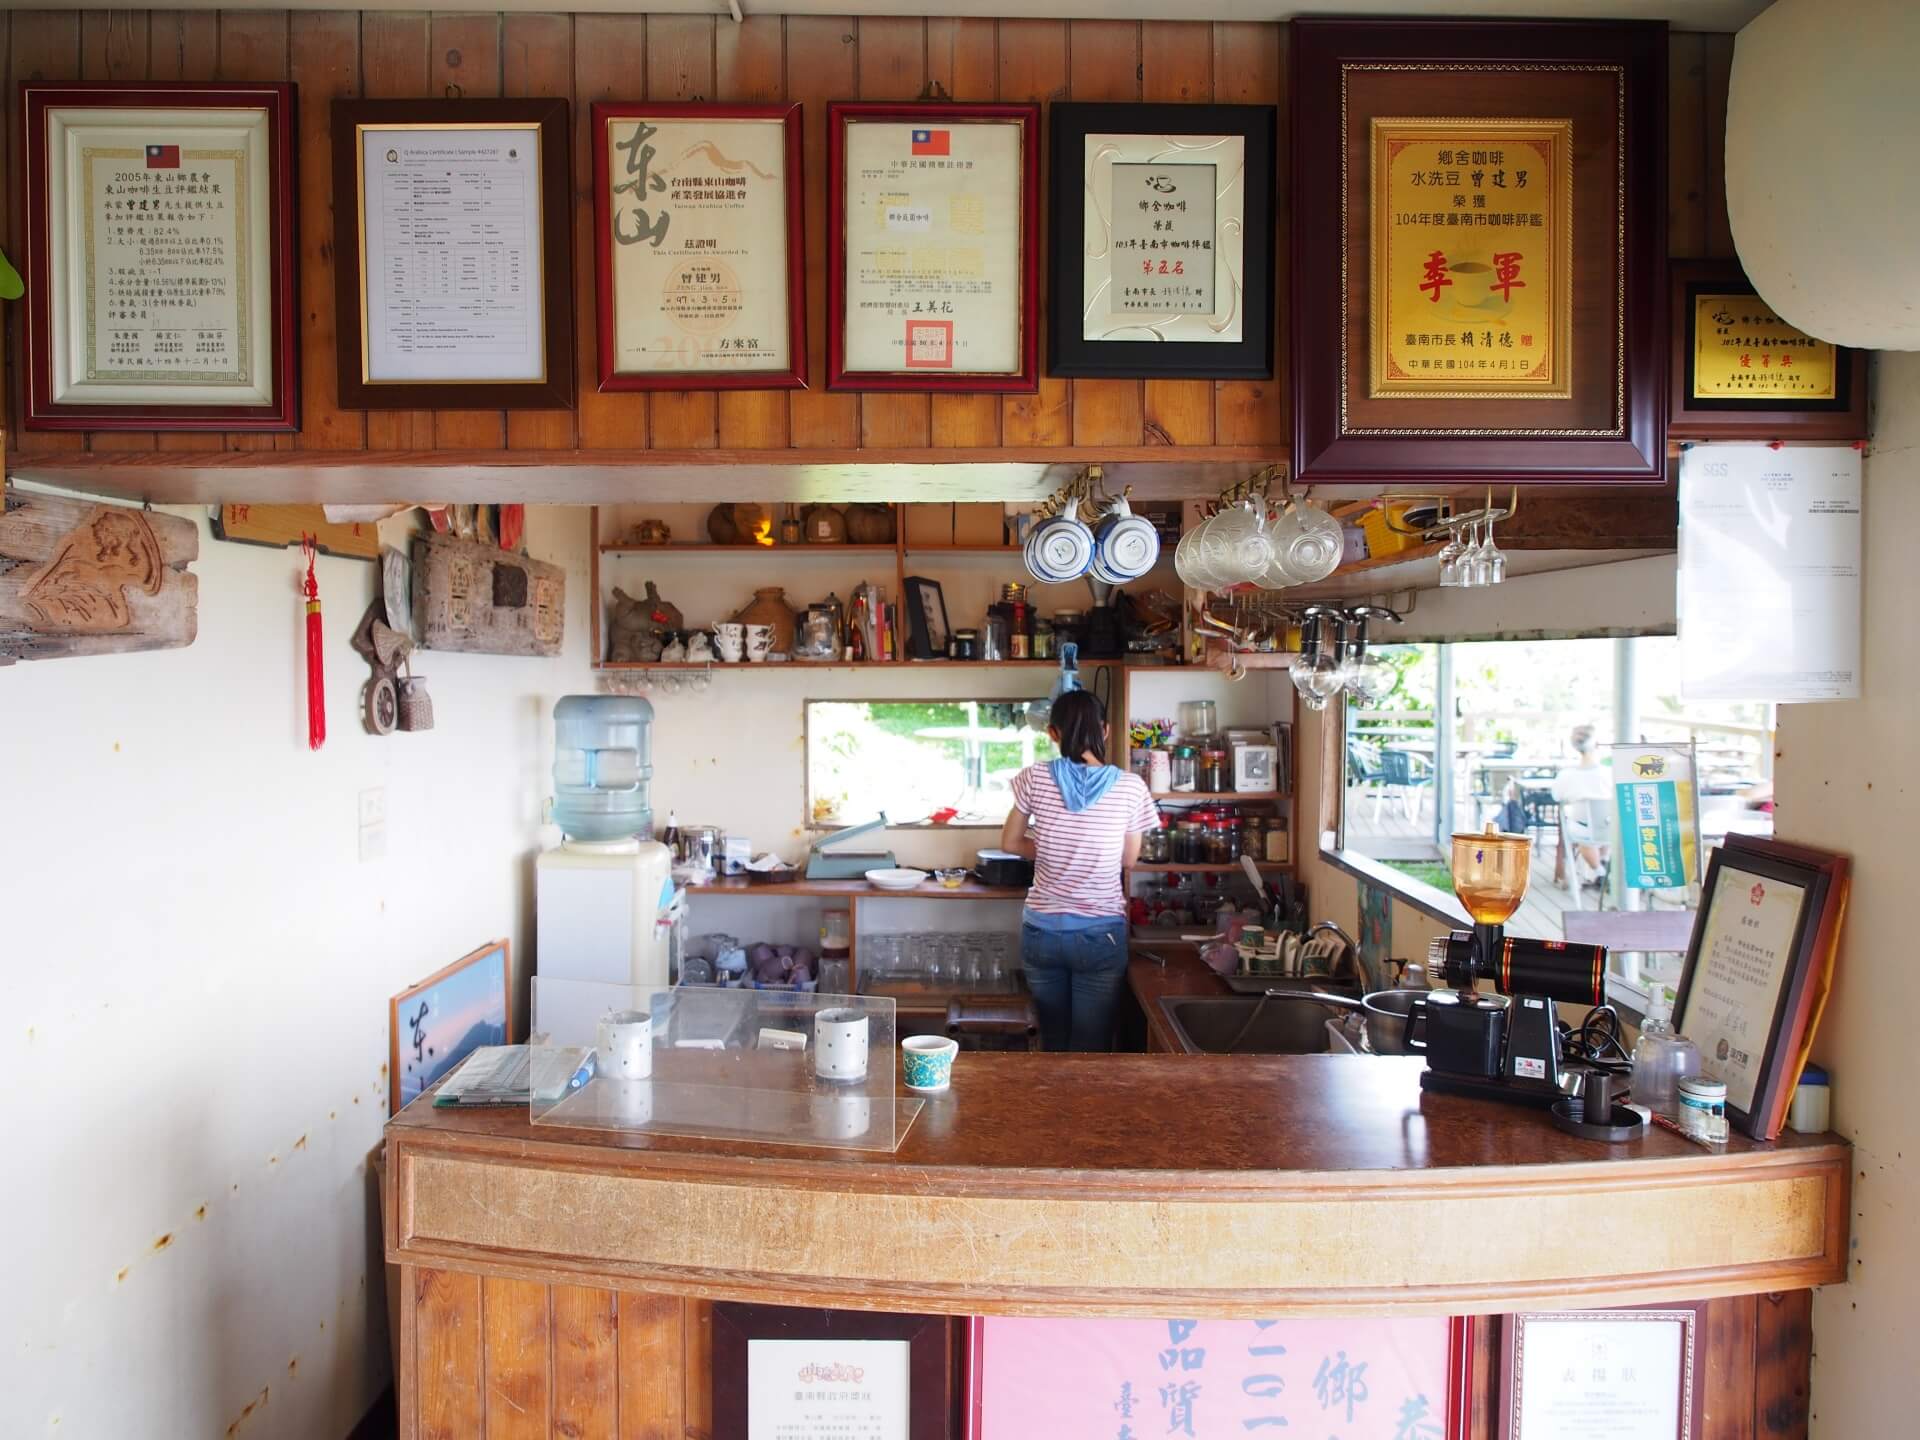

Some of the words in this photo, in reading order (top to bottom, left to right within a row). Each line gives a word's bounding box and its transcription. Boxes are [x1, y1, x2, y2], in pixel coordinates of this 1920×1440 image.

[1438, 150, 1505, 166] 鄉舍咖啡
[1411, 171, 1461, 187] 水洗豆
[1470, 169, 1529, 189] 曾建男
[1452, 194, 1487, 208] 榮獲
[1395, 212, 1543, 227] 104年度臺南市咖啡評鑑
[1142, 259, 1184, 275] 第五名
[1405, 333, 1457, 346] 臺南市長
[1460, 331, 1514, 348] 賴清德
[1408, 359, 1529, 370] 中華民國104年4月1日
[1703, 463, 1728, 477] SGS
